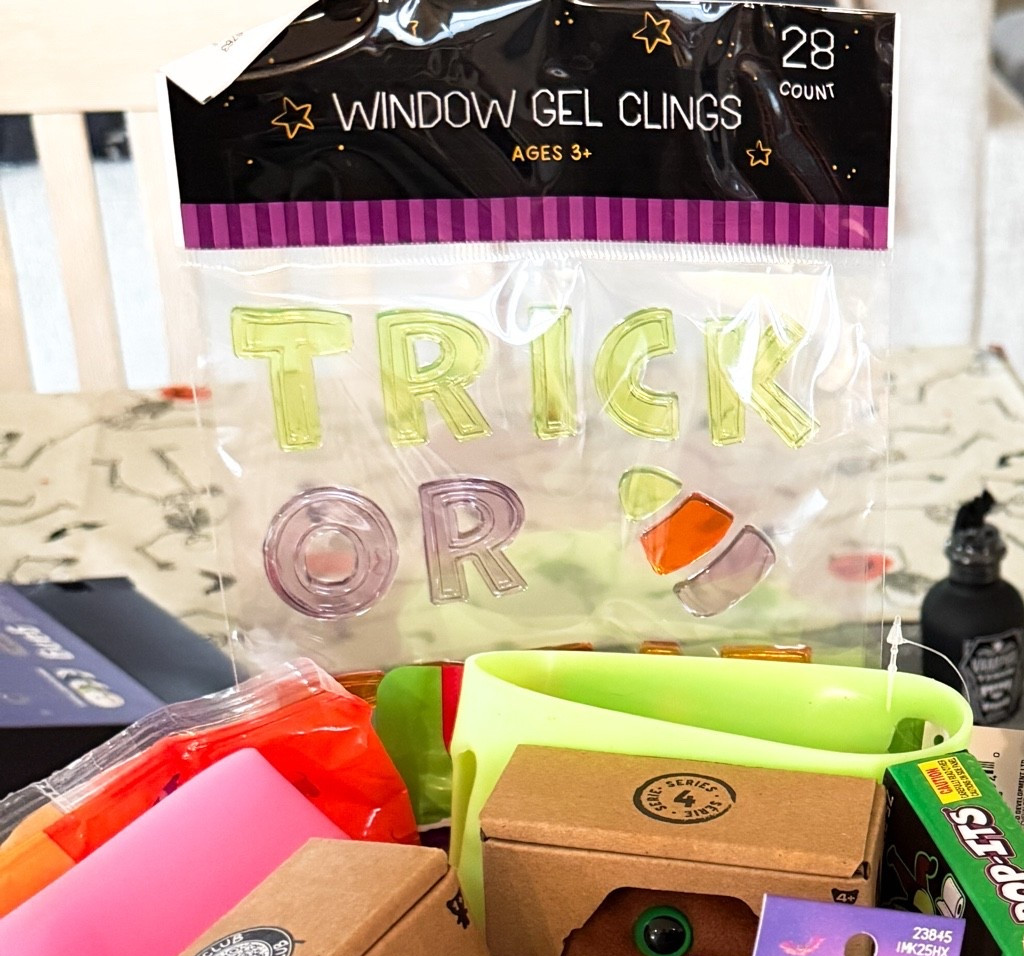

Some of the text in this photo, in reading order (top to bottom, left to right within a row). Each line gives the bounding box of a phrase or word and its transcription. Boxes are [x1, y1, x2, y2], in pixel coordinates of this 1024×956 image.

[782, 25, 835, 70] 28
[779, 81, 837, 102] COUNT
[331, 88, 743, 132] WINDOW GEL CLINGS
[512, 143, 593, 162] AGES 3+
[230, 303, 822, 452] TRICK
[262, 477, 529, 623] OR
[665, 779, 718, 792] SERIES
[925, 767, 951, 796] CAUTION
[673, 789, 696, 808] 4
[836, 893, 856, 903] 4+
[912, 926, 953, 944] 23845
